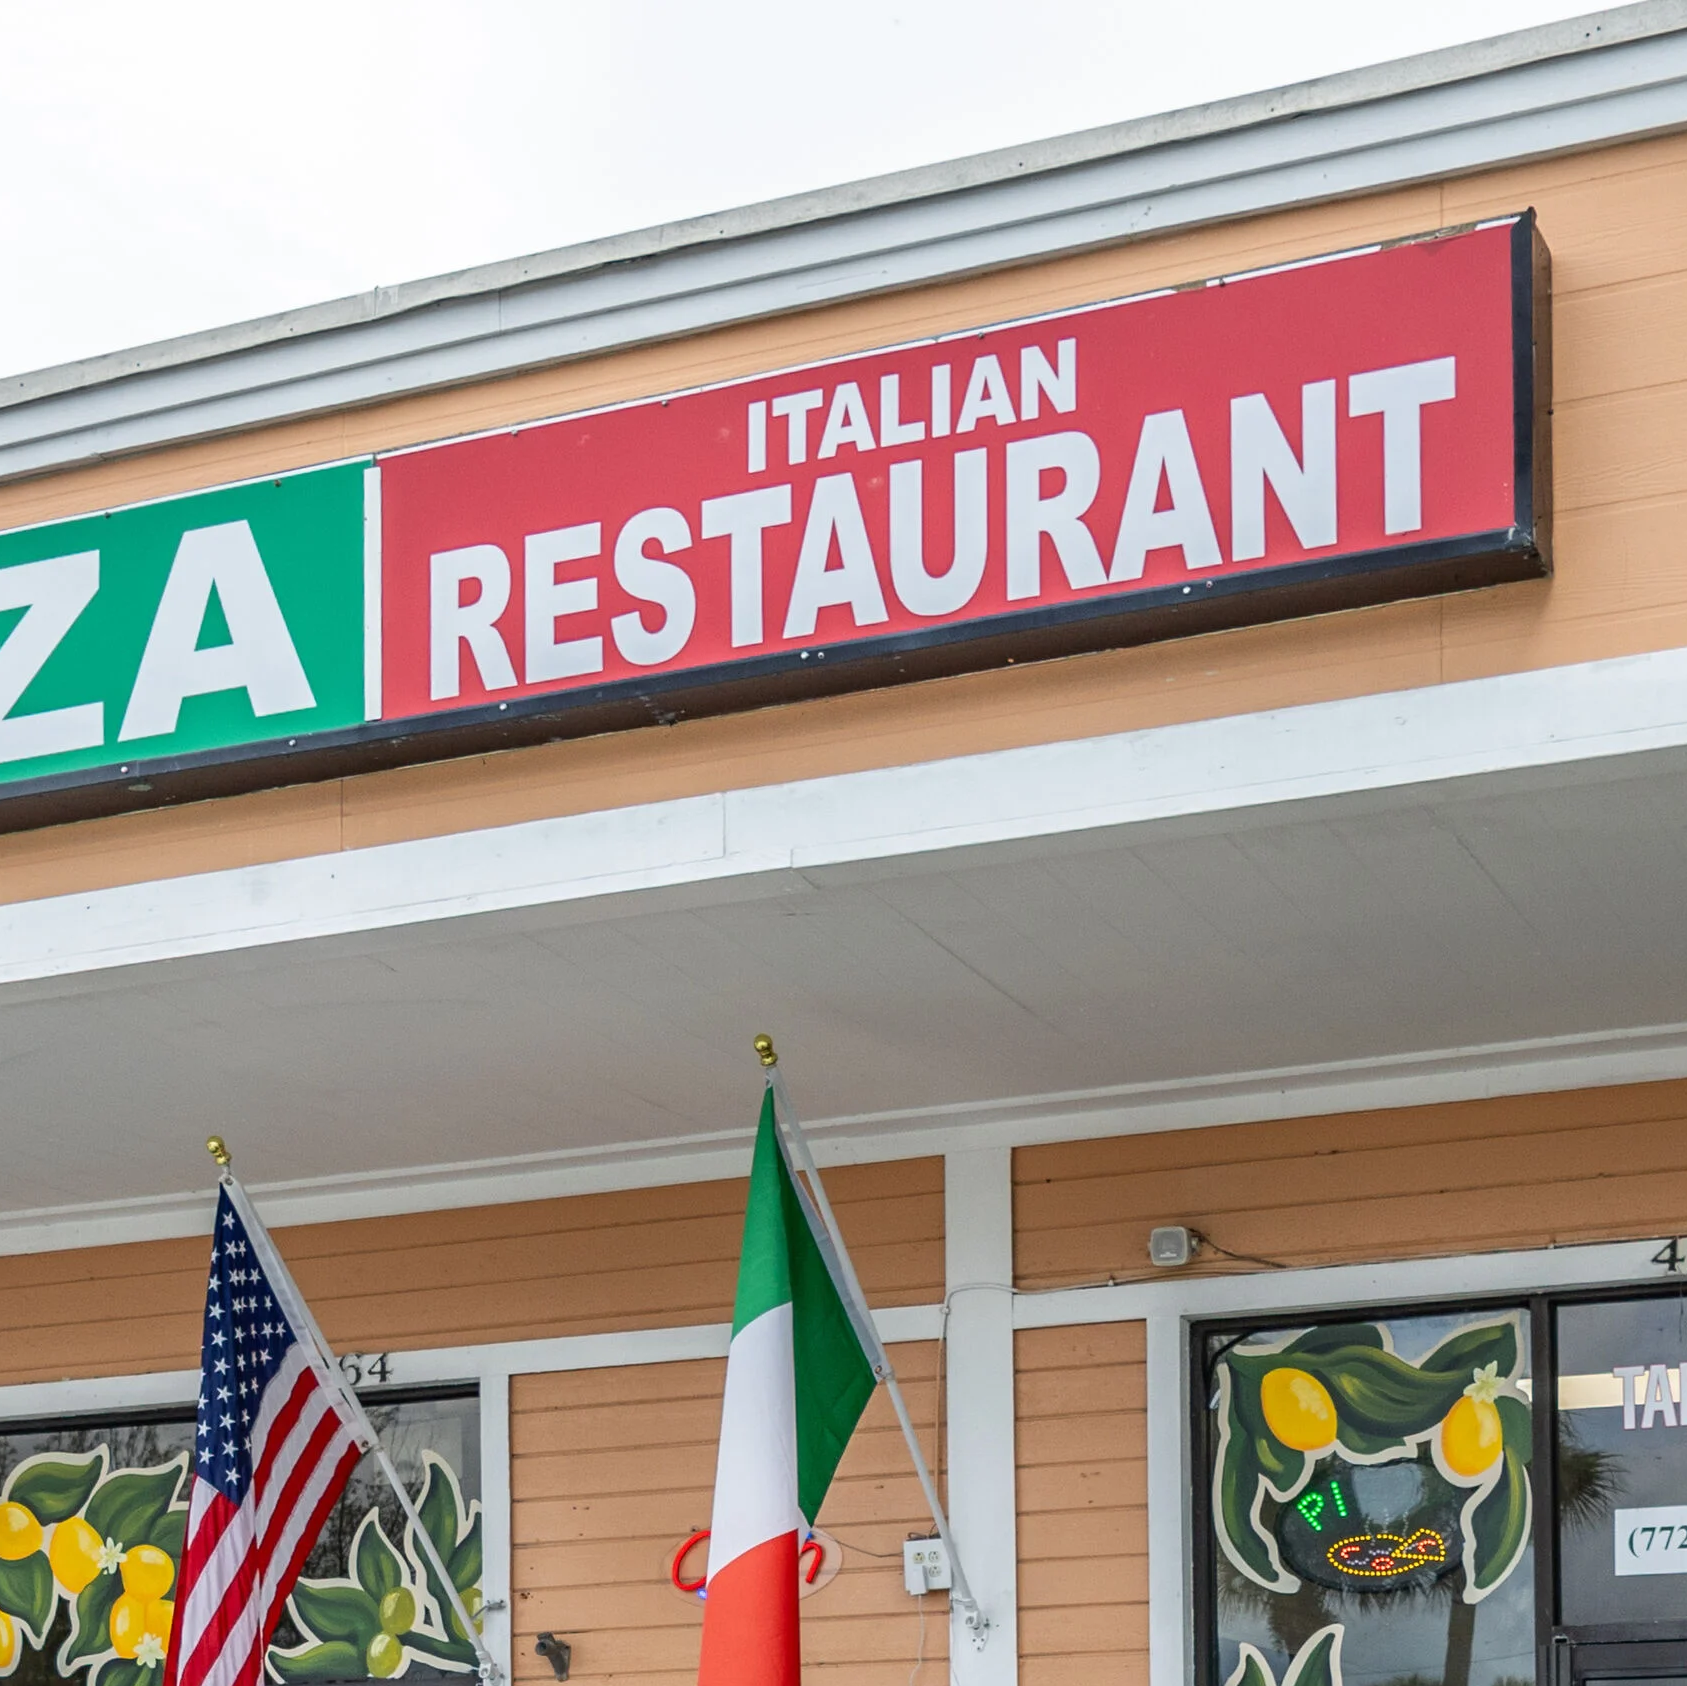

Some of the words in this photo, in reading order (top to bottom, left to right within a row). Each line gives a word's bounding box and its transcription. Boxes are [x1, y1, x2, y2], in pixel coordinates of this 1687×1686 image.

[746, 338, 1077, 470] ITALIAN
[429, 356, 1458, 702] RESTAURANT
[338, 1351, 394, 1386] 64
